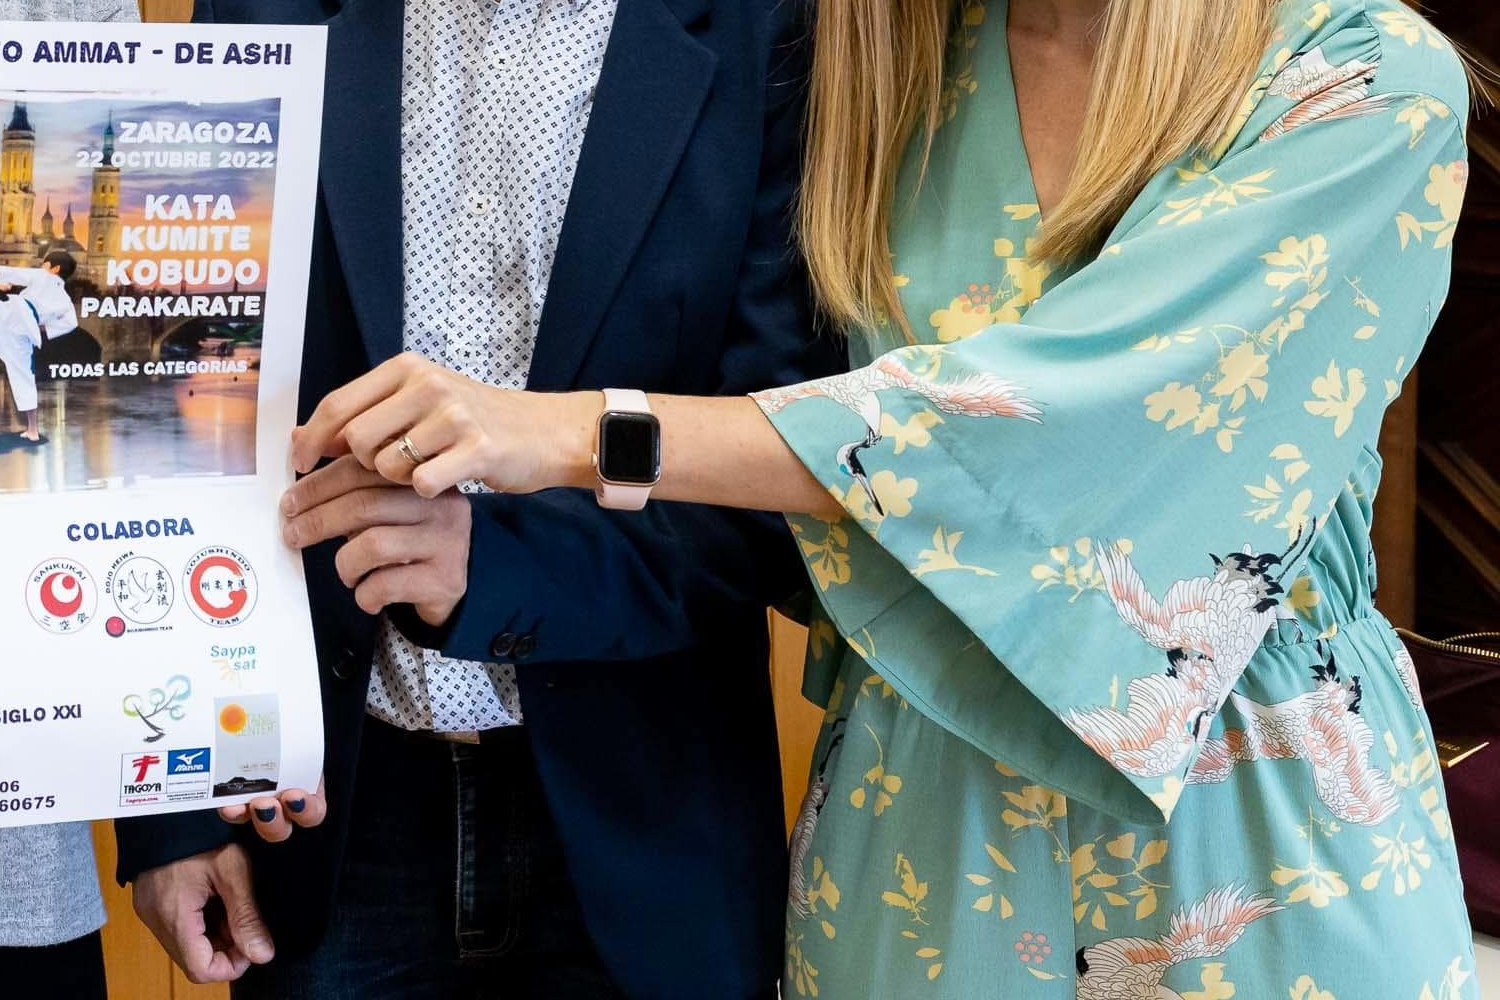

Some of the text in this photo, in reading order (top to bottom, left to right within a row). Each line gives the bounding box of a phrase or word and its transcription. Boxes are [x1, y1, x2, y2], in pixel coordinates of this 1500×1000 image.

[33, 41, 141, 64] AMMAT
[174, 43, 214, 65] DE
[223, 43, 292, 65] ASHI
[118, 121, 273, 145] ZARAGOZA
[76, 151, 277, 169] 22 OCTUBRE 2022
[144, 194, 236, 221] KATA
[120, 225, 252, 252] KUMITE
[106, 258, 261, 286] KOBUDO
[81, 296, 261, 318] PARAKARATE
[49, 363, 104, 379] TODAS
[109, 362, 139, 377] LAS
[66, 517, 195, 542] COLABORA
[33, 562, 87, 583] SANKUKAI
[105, 569, 114, 594] DOJO
[209, 616, 239, 625] TEAM
[210, 645, 256, 659] Saypa
[233, 659, 256, 671] sat
[53, 703, 82, 720] XXI
[124, 782, 161, 795] TAGOYA
